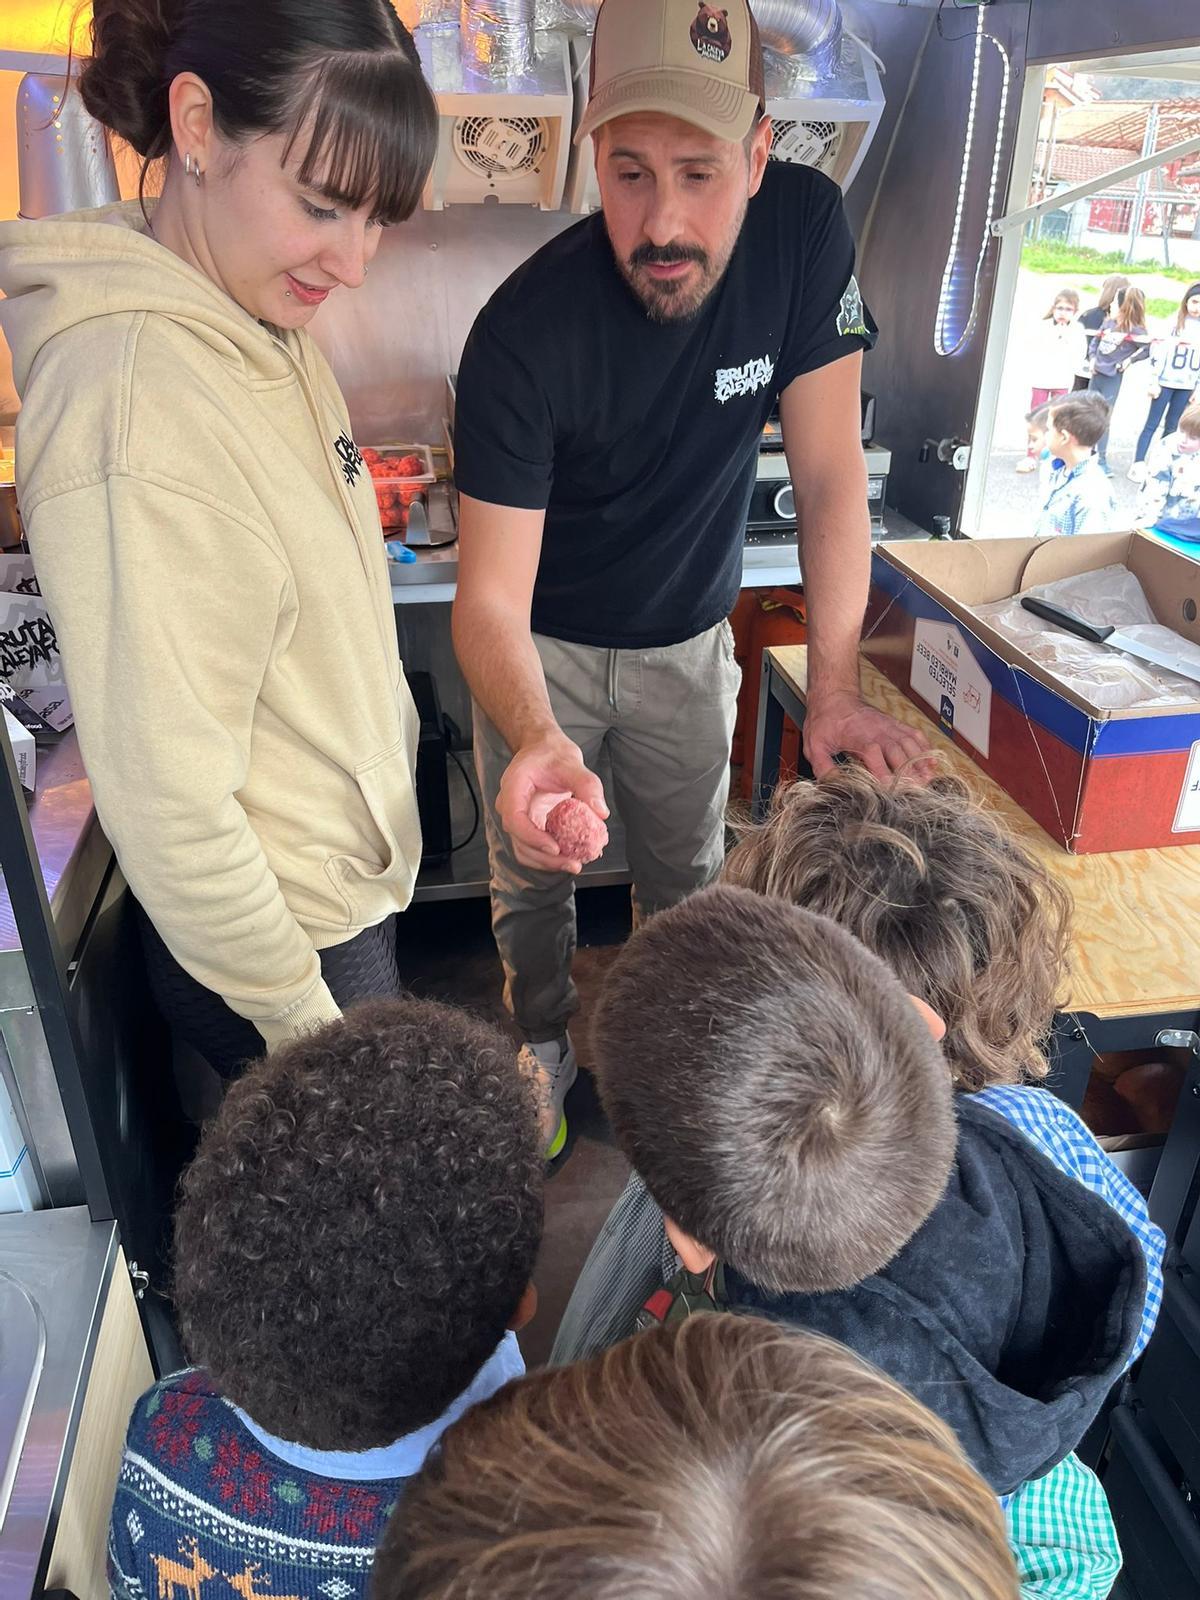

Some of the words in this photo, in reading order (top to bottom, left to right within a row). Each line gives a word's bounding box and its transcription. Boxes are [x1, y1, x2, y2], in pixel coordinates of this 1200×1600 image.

[715, 354, 774, 384] BRUTAL
[917, 642, 930, 661] BEEF
[928, 665, 956, 697] SELECTED
[931, 655, 957, 685] MARBLED
